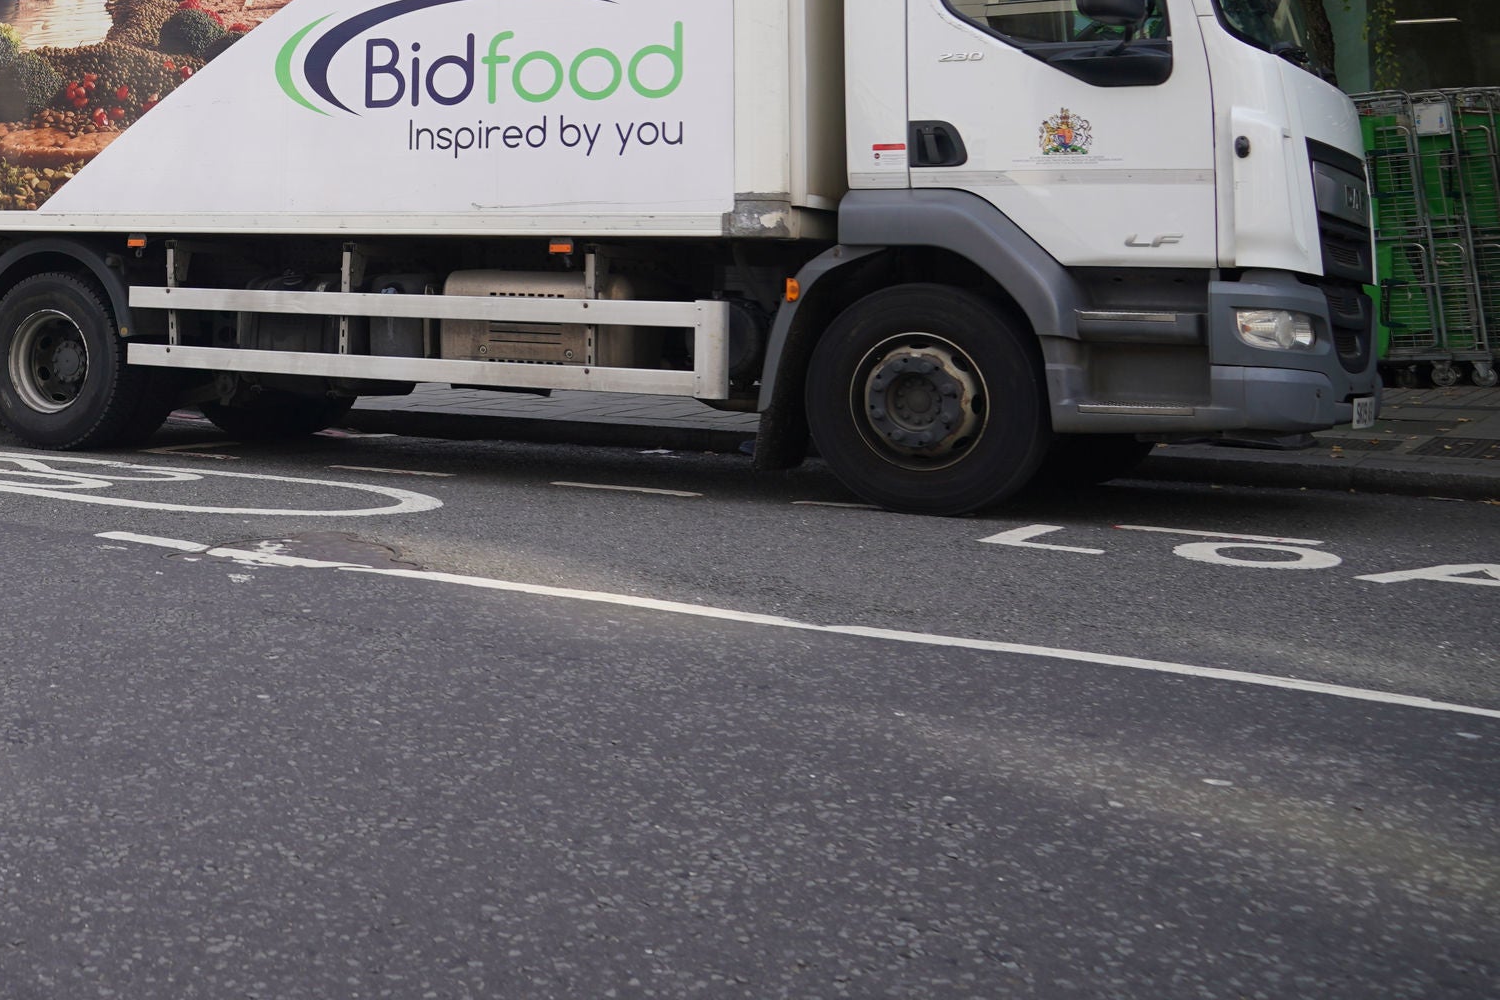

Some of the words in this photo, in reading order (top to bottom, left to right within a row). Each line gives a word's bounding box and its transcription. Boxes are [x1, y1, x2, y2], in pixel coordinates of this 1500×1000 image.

[364, 21, 684, 108] Bidfood
[938, 52, 985, 62] 230
[408, 116, 547, 158] Inspired
[560, 115, 601, 156] by
[616, 121, 684, 156] you
[1124, 232, 1184, 248] LF
